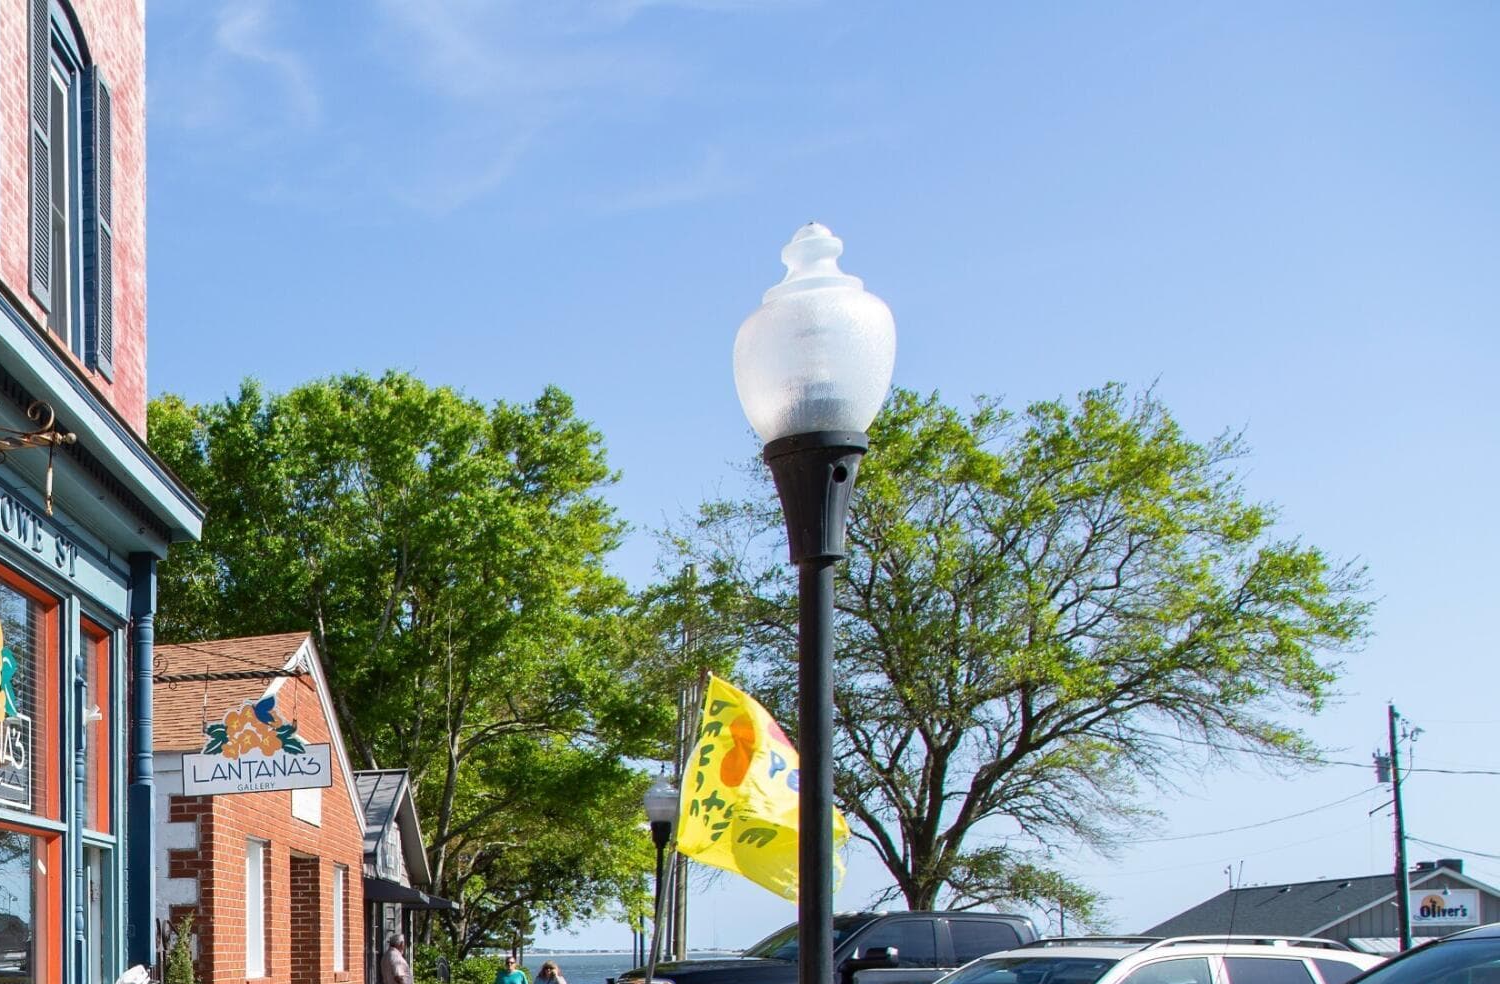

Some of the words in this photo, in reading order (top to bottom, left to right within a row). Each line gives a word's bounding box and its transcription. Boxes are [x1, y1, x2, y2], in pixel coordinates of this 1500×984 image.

[55, 534, 78, 577] ST
[193, 754, 321, 783] LANTANA'S
[237, 782, 276, 792] GALLERY
